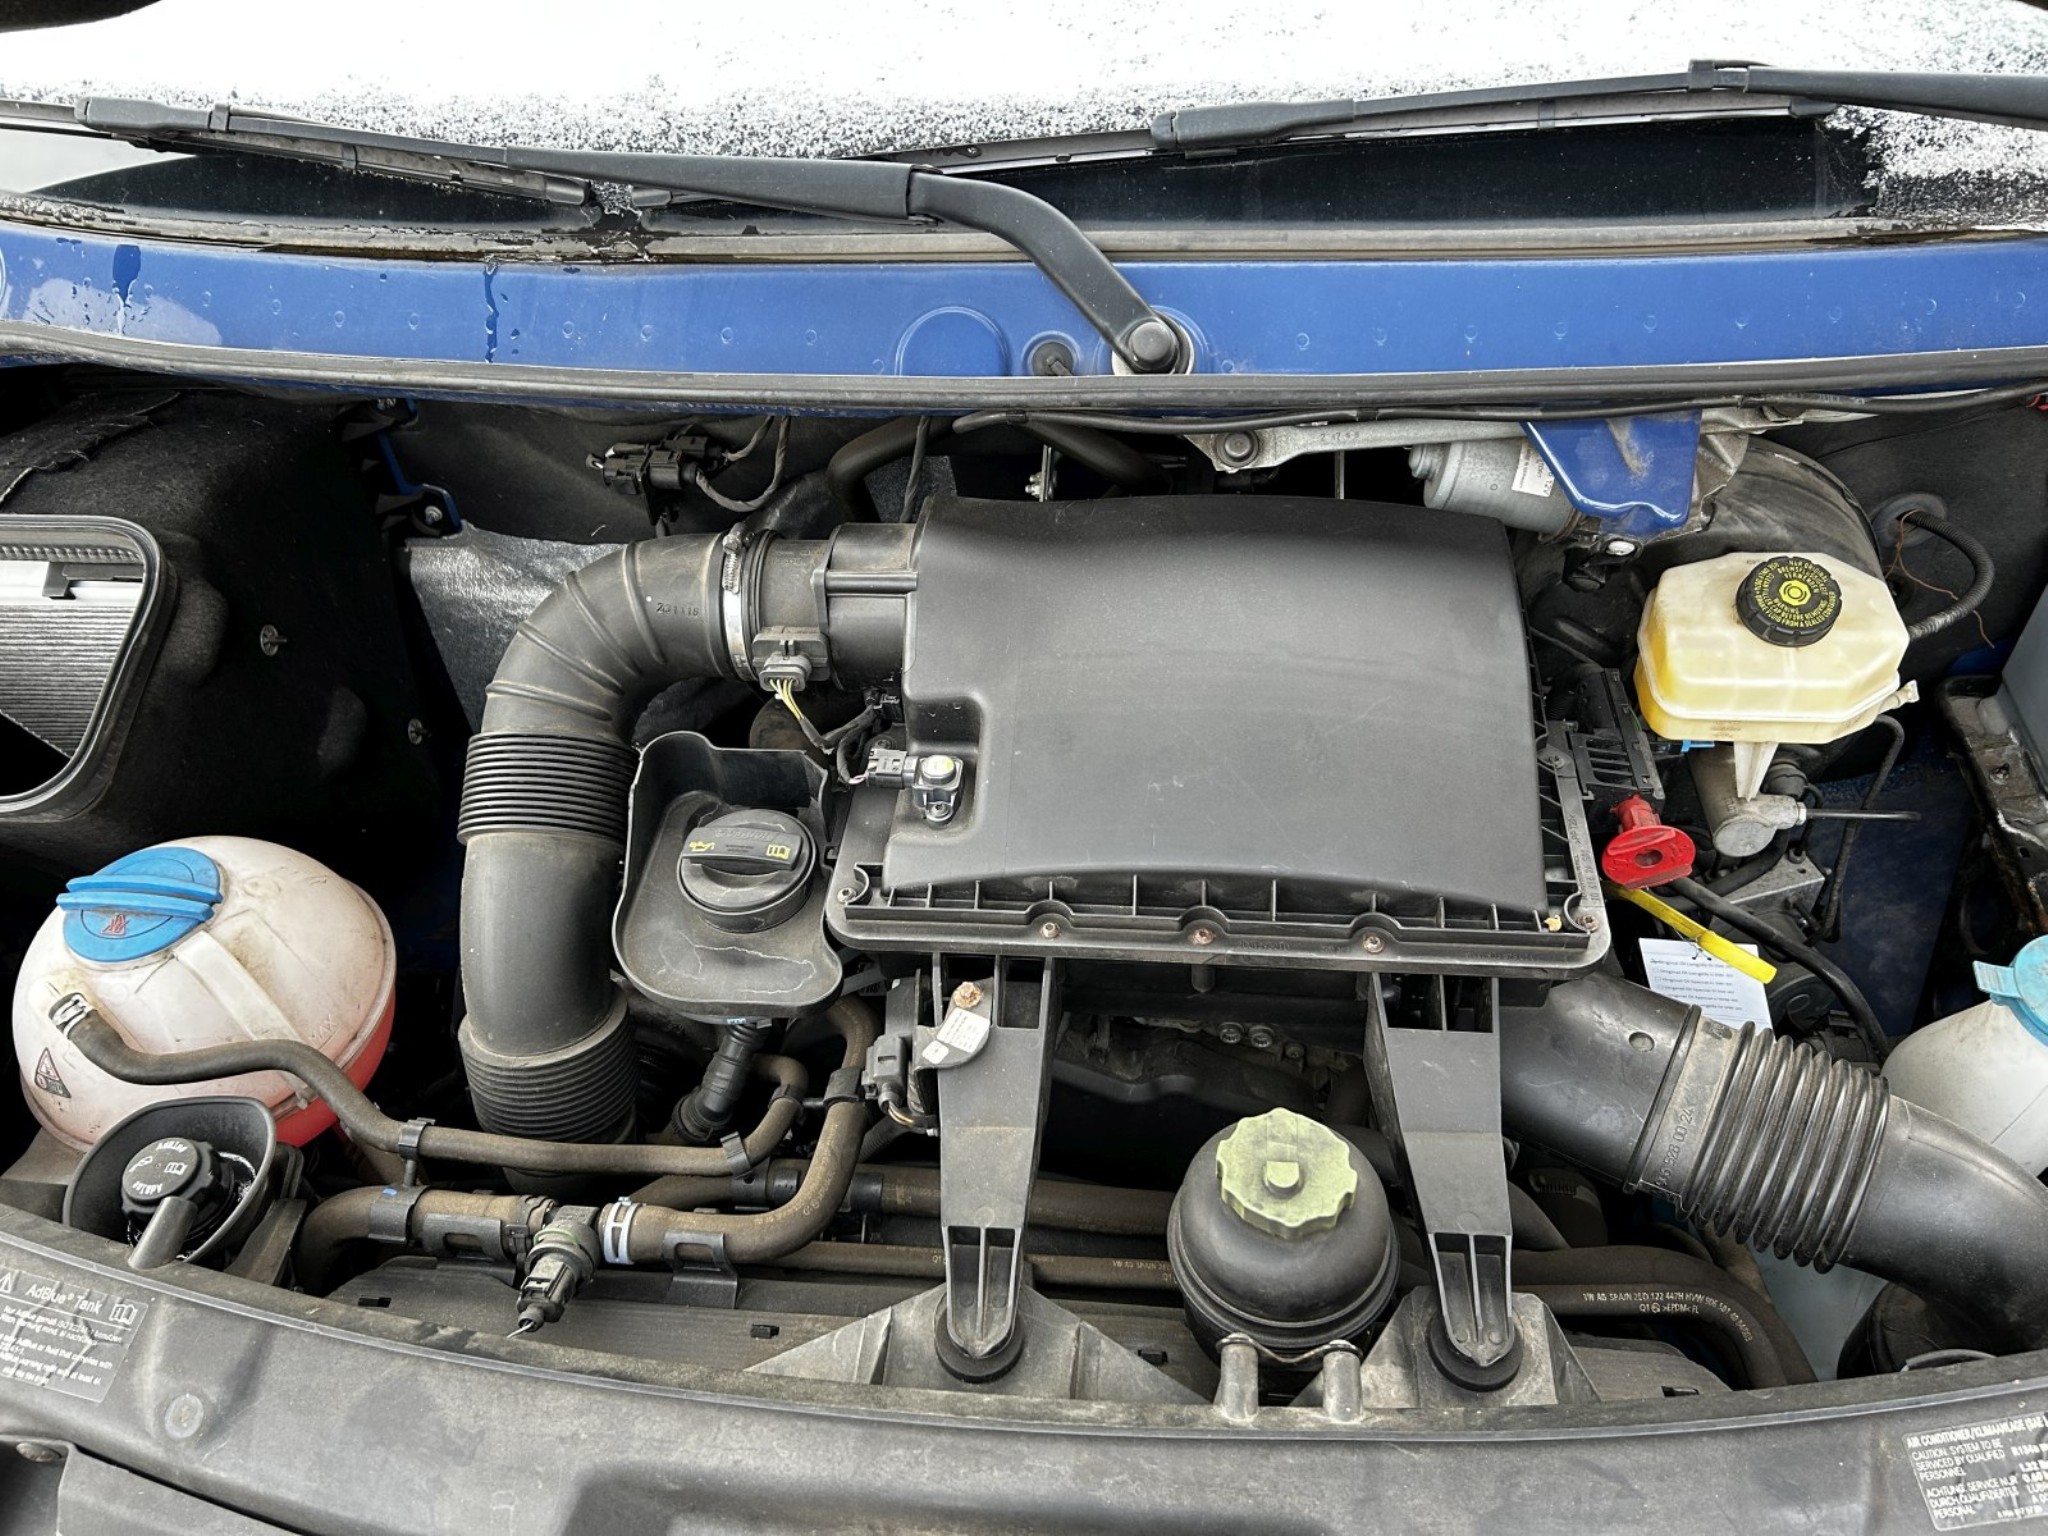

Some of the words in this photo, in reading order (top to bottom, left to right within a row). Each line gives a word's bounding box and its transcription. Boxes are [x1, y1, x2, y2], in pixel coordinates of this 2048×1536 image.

[1650, 1292, 1664, 1300] 122
[75, 1295, 103, 1314] Tank
[1949, 1441, 1979, 1456] SYSTEM
[1980, 1440, 1991, 1450] TO
[1915, 1457, 1954, 1472] SERVICED
[1954, 1455, 1966, 1466] BY
[1965, 1449, 2006, 1464] QUALIFIED
[1919, 1466, 1967, 1482] PERSONNEL
[1966, 1477, 1999, 1489] SERVICE
[1929, 1496, 1959, 1509] DURCH
[1933, 1504, 1977, 1519] PERSONAL
